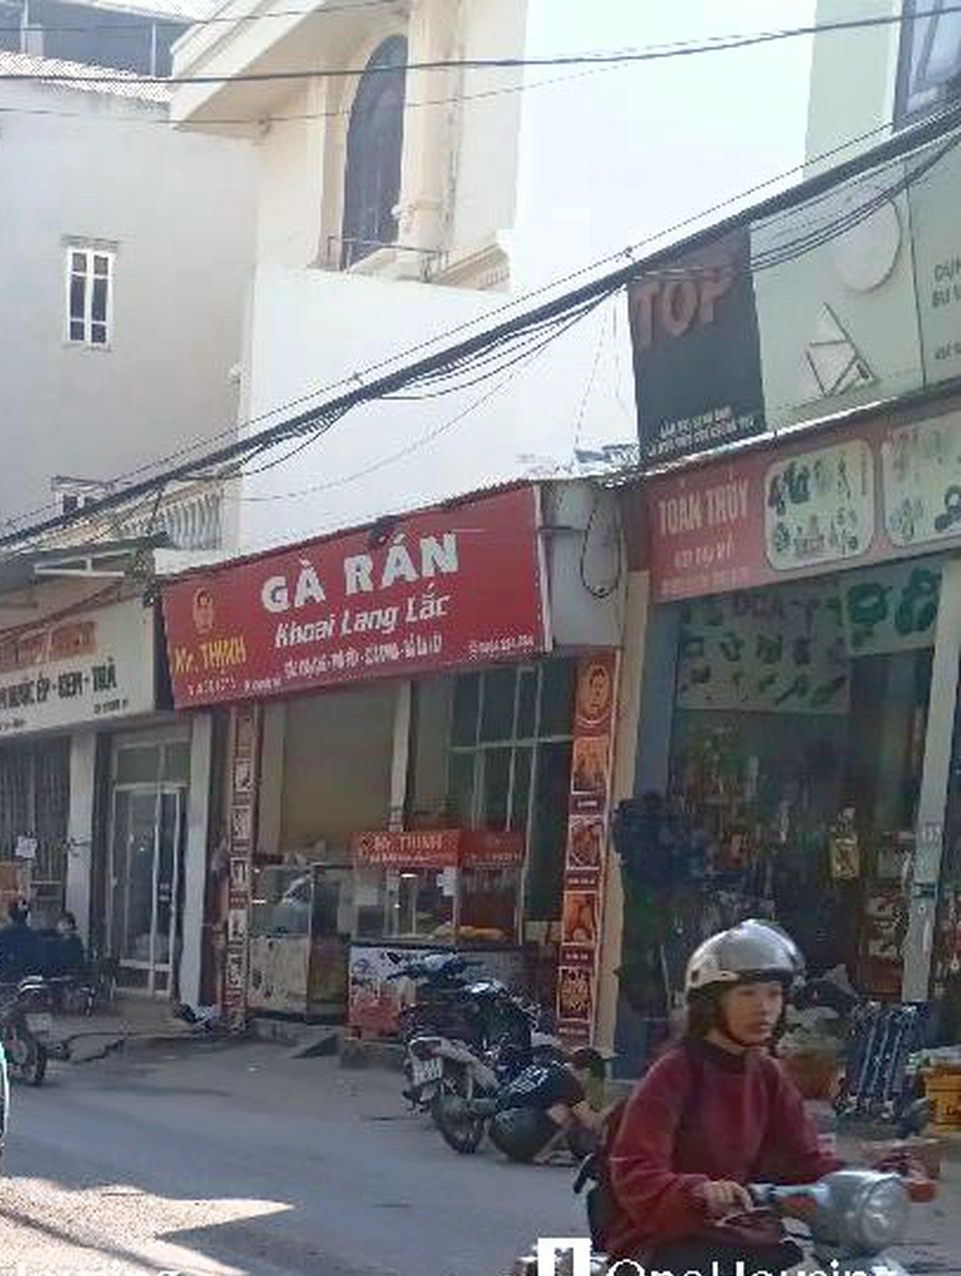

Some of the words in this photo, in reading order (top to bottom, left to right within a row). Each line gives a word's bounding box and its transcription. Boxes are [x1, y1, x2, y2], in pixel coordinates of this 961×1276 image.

[261, 557, 326, 614] GÀ
[343, 533, 459, 597] RÁN
[275, 612, 335, 649] Khoai
[341, 605, 400, 635] Lang
[405, 582, 451, 623] Lắc
